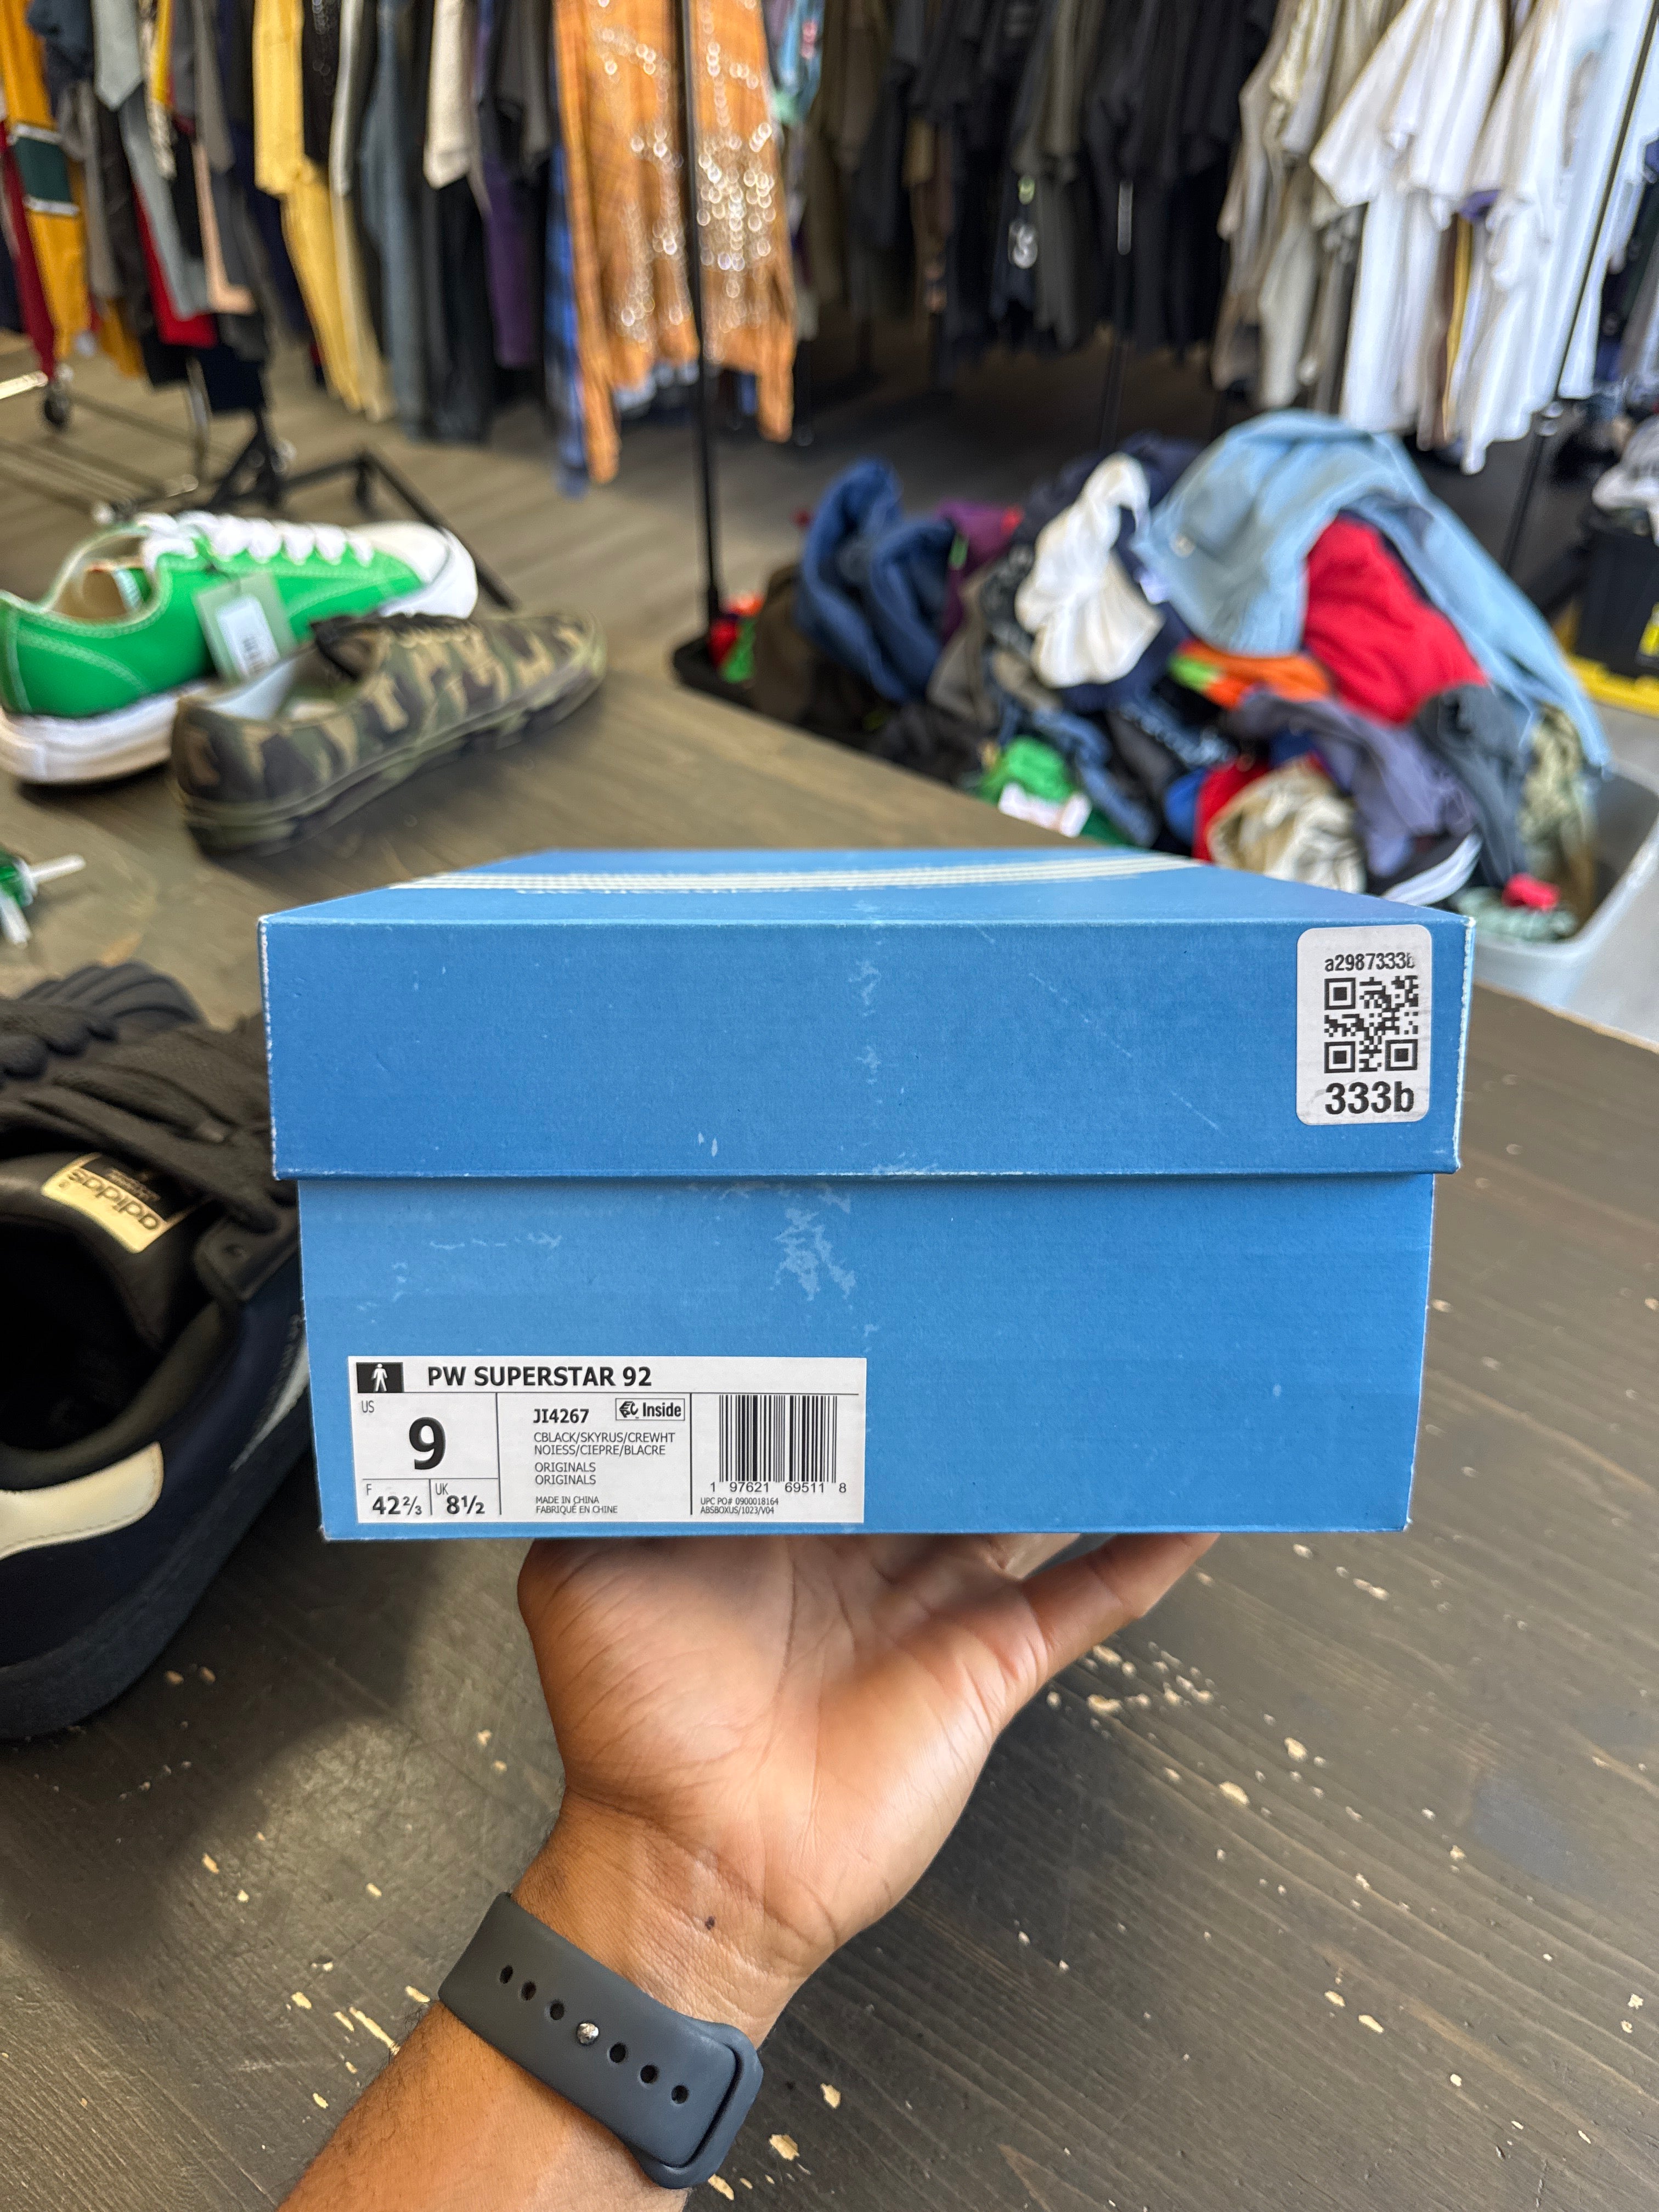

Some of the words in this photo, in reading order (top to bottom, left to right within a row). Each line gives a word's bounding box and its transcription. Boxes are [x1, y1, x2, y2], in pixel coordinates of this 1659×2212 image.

[1324, 1081, 1414, 1115] 333b
[427, 1365, 466, 1386] PW
[474, 1365, 616, 1387] SUPERSTAR
[622, 1366, 652, 1387] 92
[361, 1400, 374, 1413] US
[642, 1402, 681, 1418] Inside
[533, 1408, 589, 1424] JI4267
[409, 1416, 446, 1470] 9
[534, 1431, 675, 1444] CBLACK/SKYRUS/CREWHT
[534, 1443, 665, 1457] NOIESS/CIEPRE/BLACRE
[535, 1462, 596, 1473] ORIGINALS
[535, 1475, 596, 1486] ORIGINALS
[366, 1484, 371, 1495] F
[436, 1483, 448, 1495] UK
[710, 1482, 715, 1492] 1
[730, 1482, 768, 1492] 97621
[785, 1482, 823, 1493] 69511
[839, 1483, 846, 1493] 8
[535, 1496, 559, 1505] MADE
[561, 1496, 571, 1505] IN
[573, 1496, 600, 1505] CHINA
[700, 1497, 715, 1505] UPC
[717, 1497, 732, 1505] PO#
[735, 1497, 778, 1505] 0900018164
[535, 1503, 577, 1514] FABRIQUÉ
[579, 1504, 590, 1514] EN
[592, 1504, 618, 1514] CHINE
[700, 1506, 774, 1515] ABSBOXUS/1023/V04
